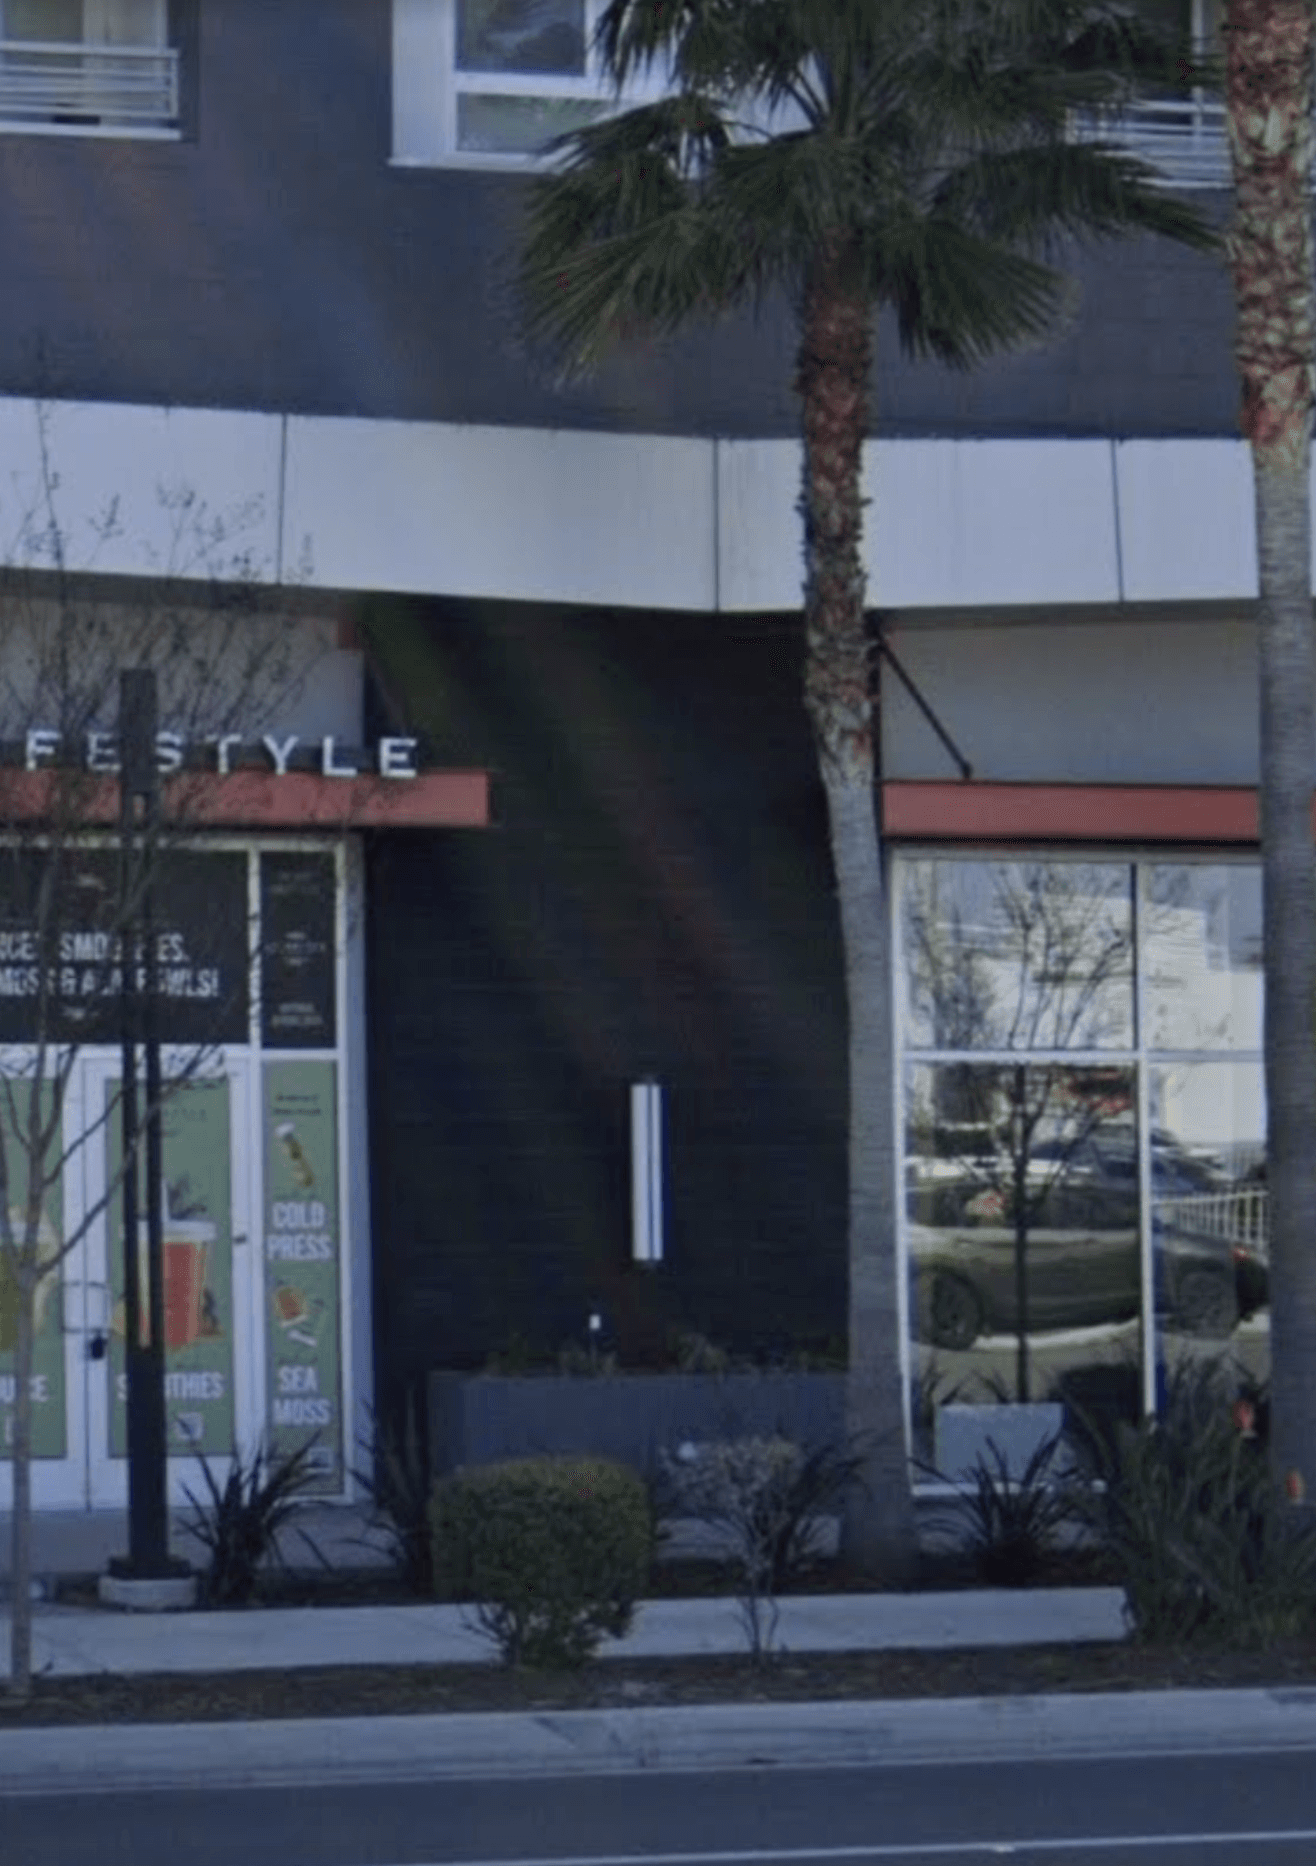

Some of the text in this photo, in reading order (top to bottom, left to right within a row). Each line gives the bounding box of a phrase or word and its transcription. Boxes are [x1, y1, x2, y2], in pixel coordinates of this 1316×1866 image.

[272, 1201, 325, 1229] COLD
[266, 1233, 333, 1261] PRESS
[115, 1371, 224, 1401] STHIES
[278, 1365, 319, 1392] SEA
[272, 1398, 332, 1426] MOSS
